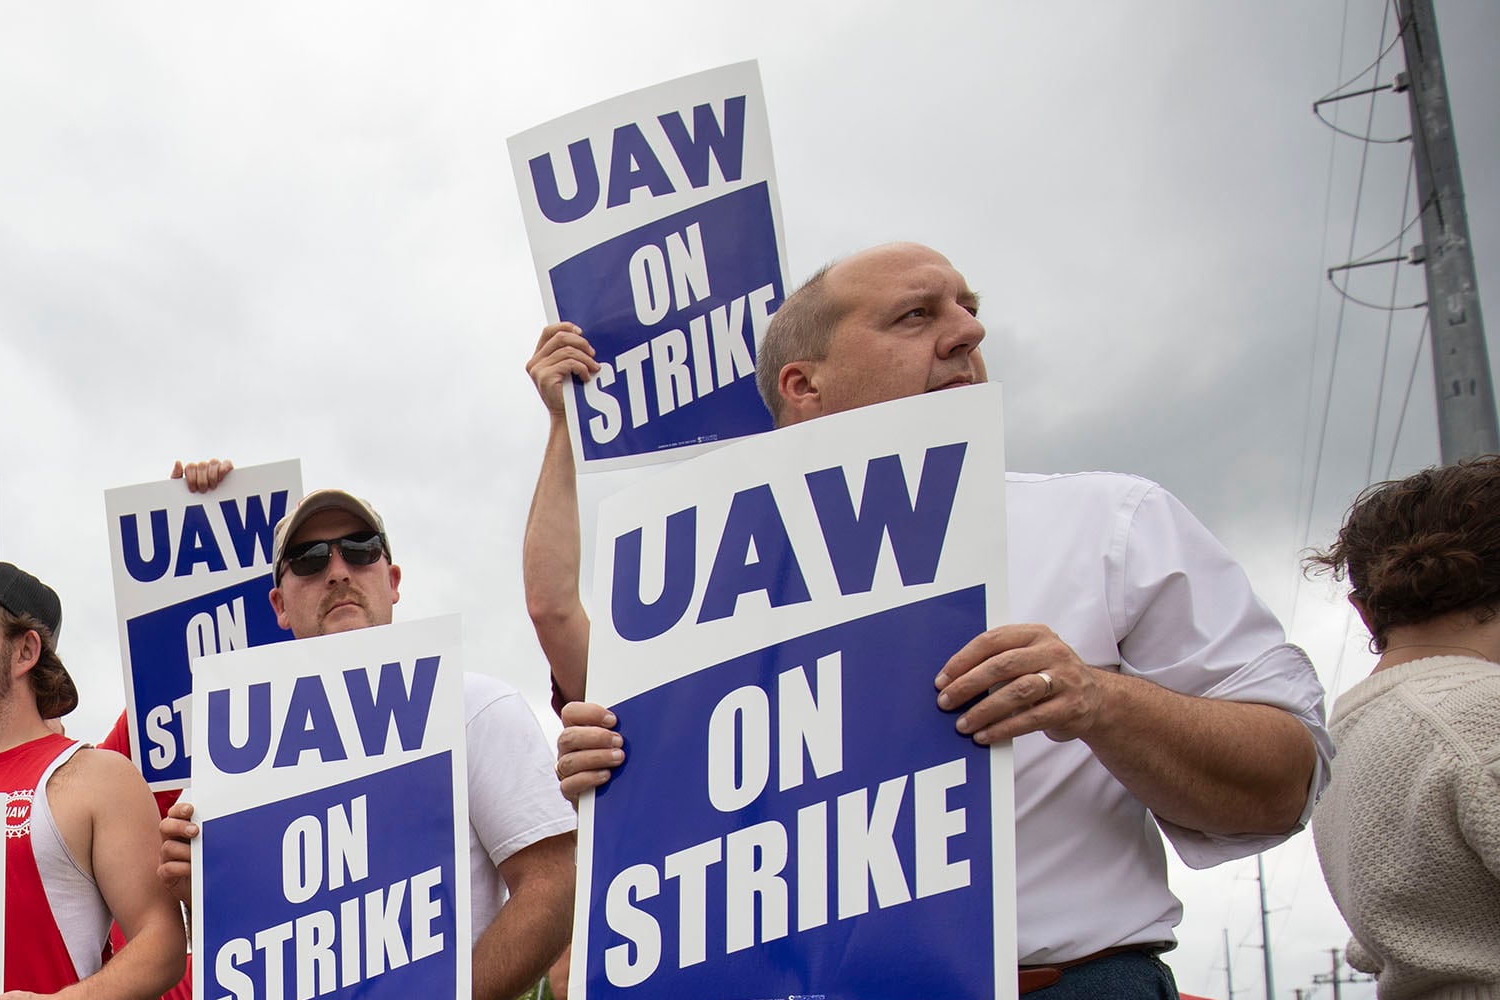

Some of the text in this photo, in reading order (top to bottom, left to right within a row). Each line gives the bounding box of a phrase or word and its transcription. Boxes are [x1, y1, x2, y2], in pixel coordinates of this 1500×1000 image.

[528, 95, 746, 224] UAW
[629, 222, 711, 326] ON
[119, 490, 289, 583] UAW
[611, 442, 968, 642] UAW
[207, 655, 441, 775] UAW
[708, 650, 843, 812] ON
[282, 794, 369, 904] ON
[604, 757, 971, 988] STRIKE
